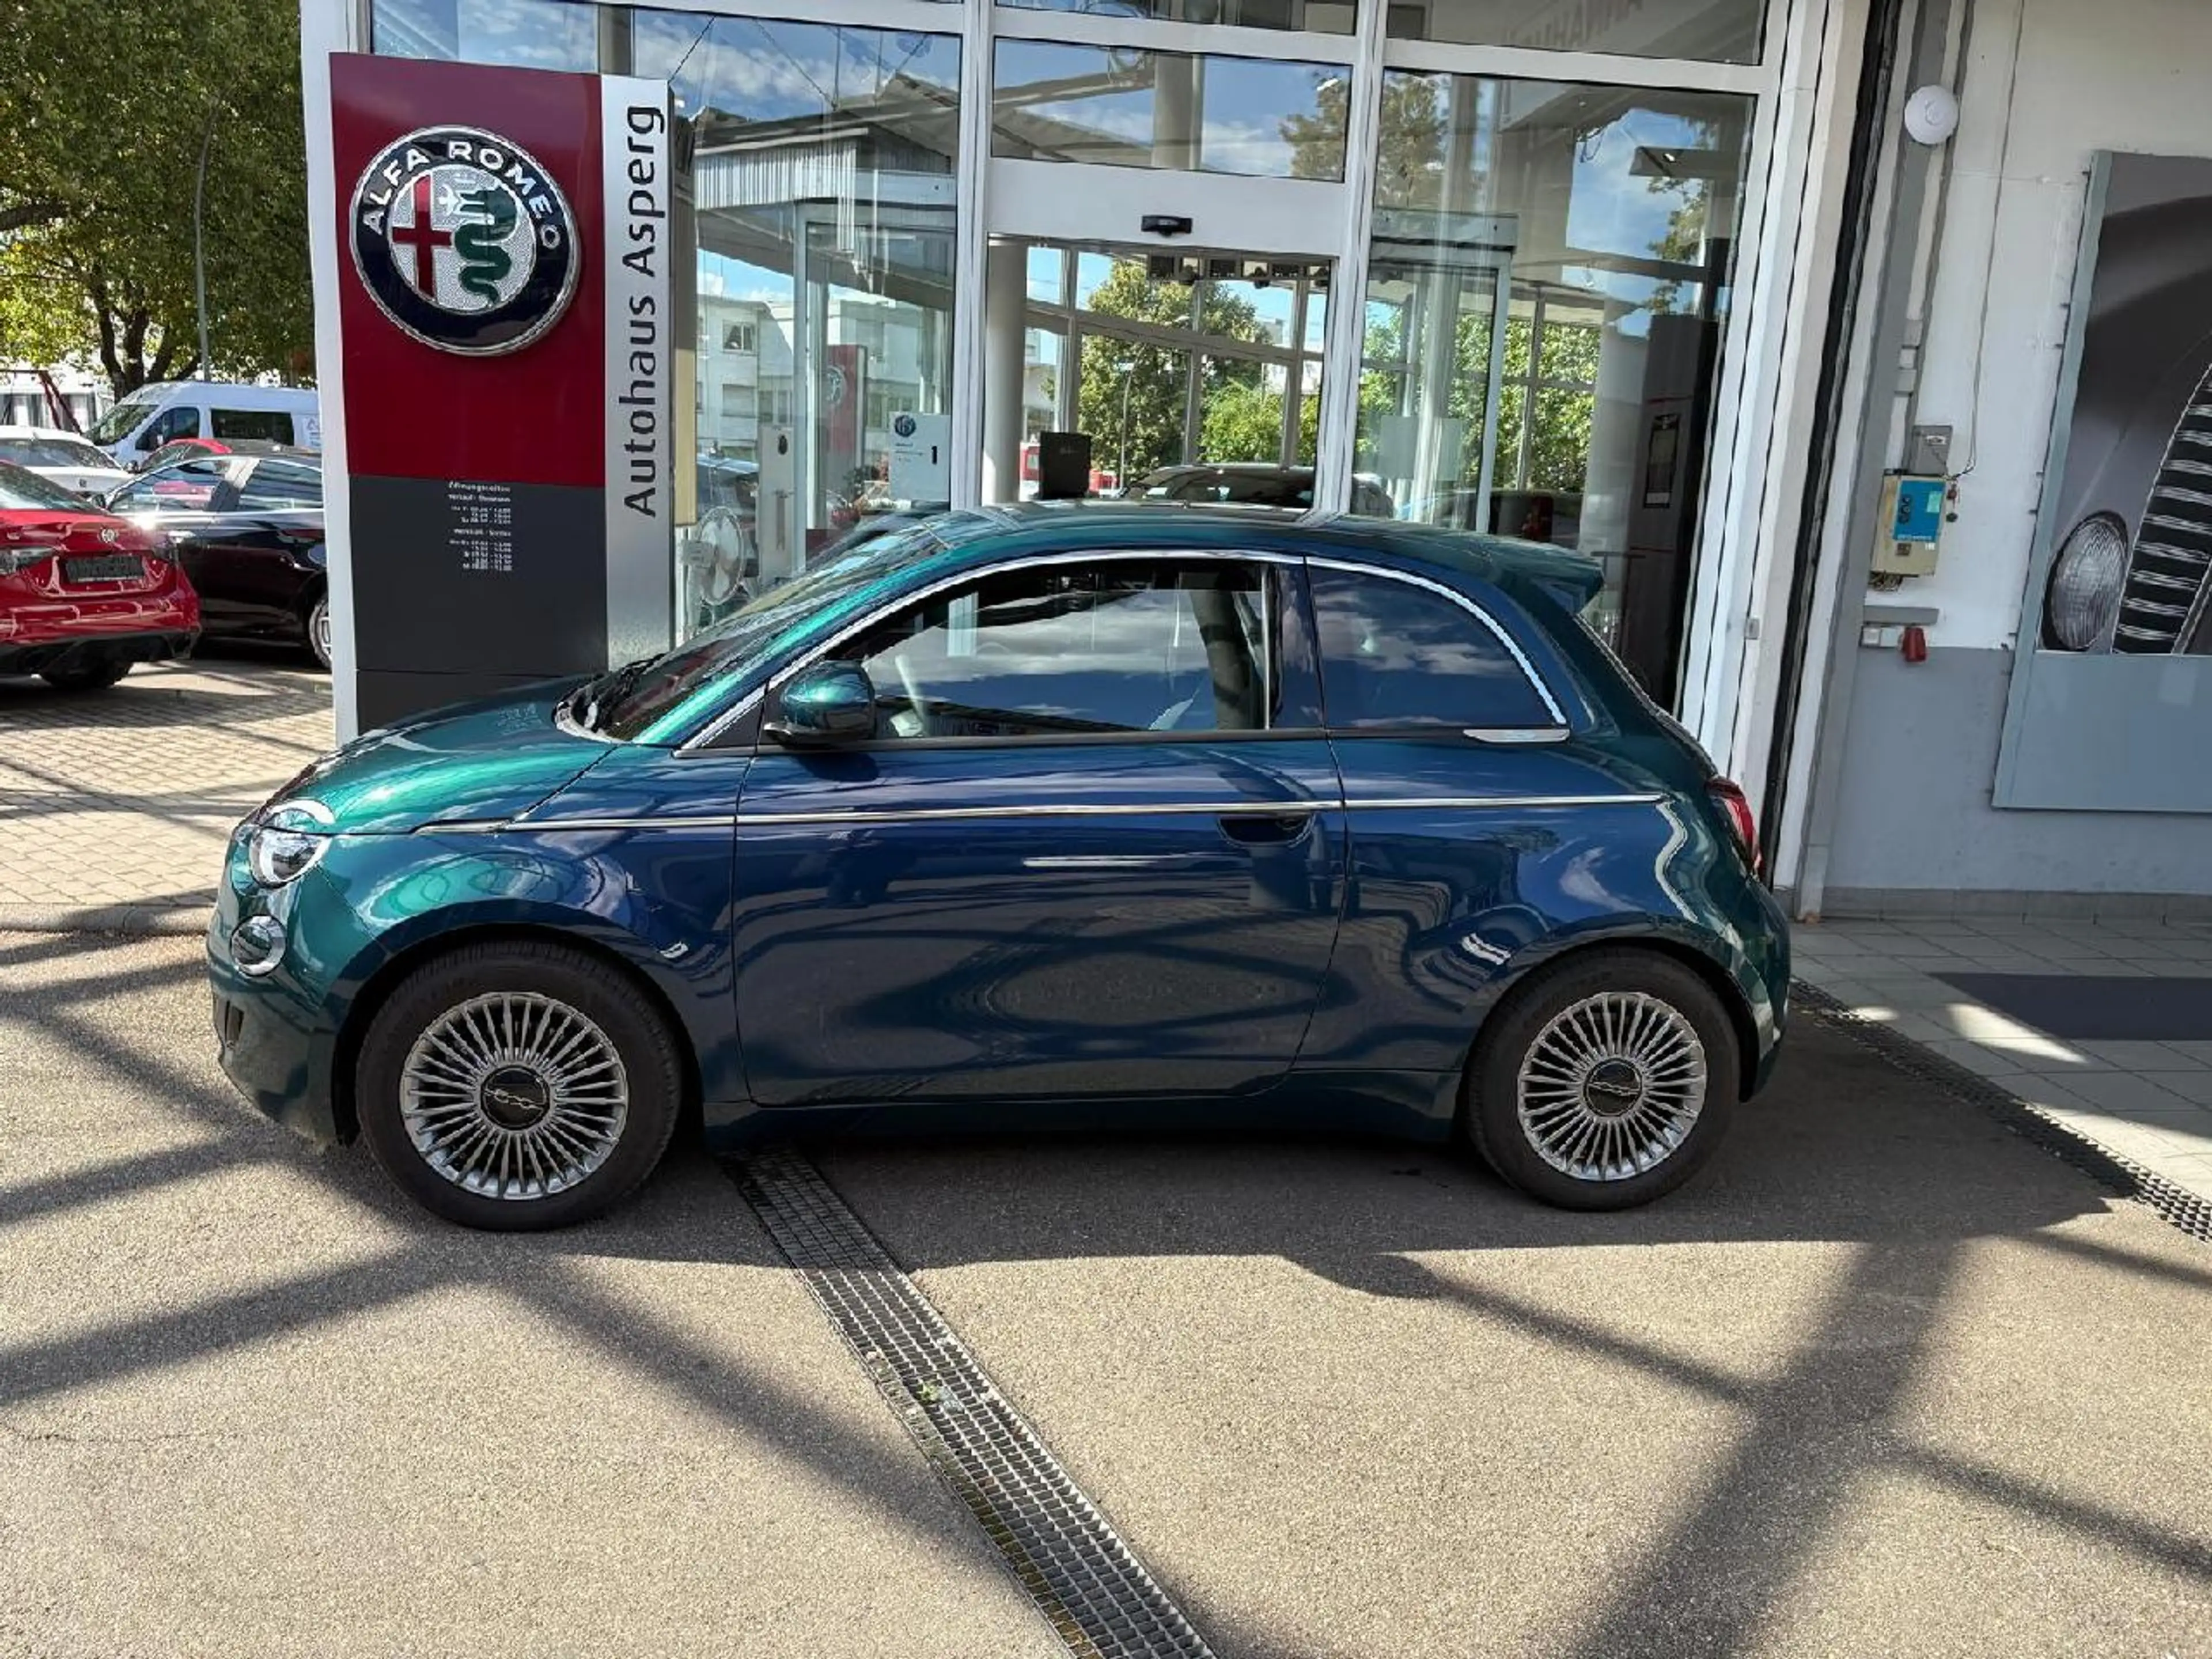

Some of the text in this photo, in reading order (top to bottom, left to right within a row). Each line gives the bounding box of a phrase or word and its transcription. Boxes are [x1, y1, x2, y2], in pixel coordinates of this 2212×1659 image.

[362, 140, 562, 249] ALFA ROMEO
[619, 106, 665, 518] Autohaus Asperg
